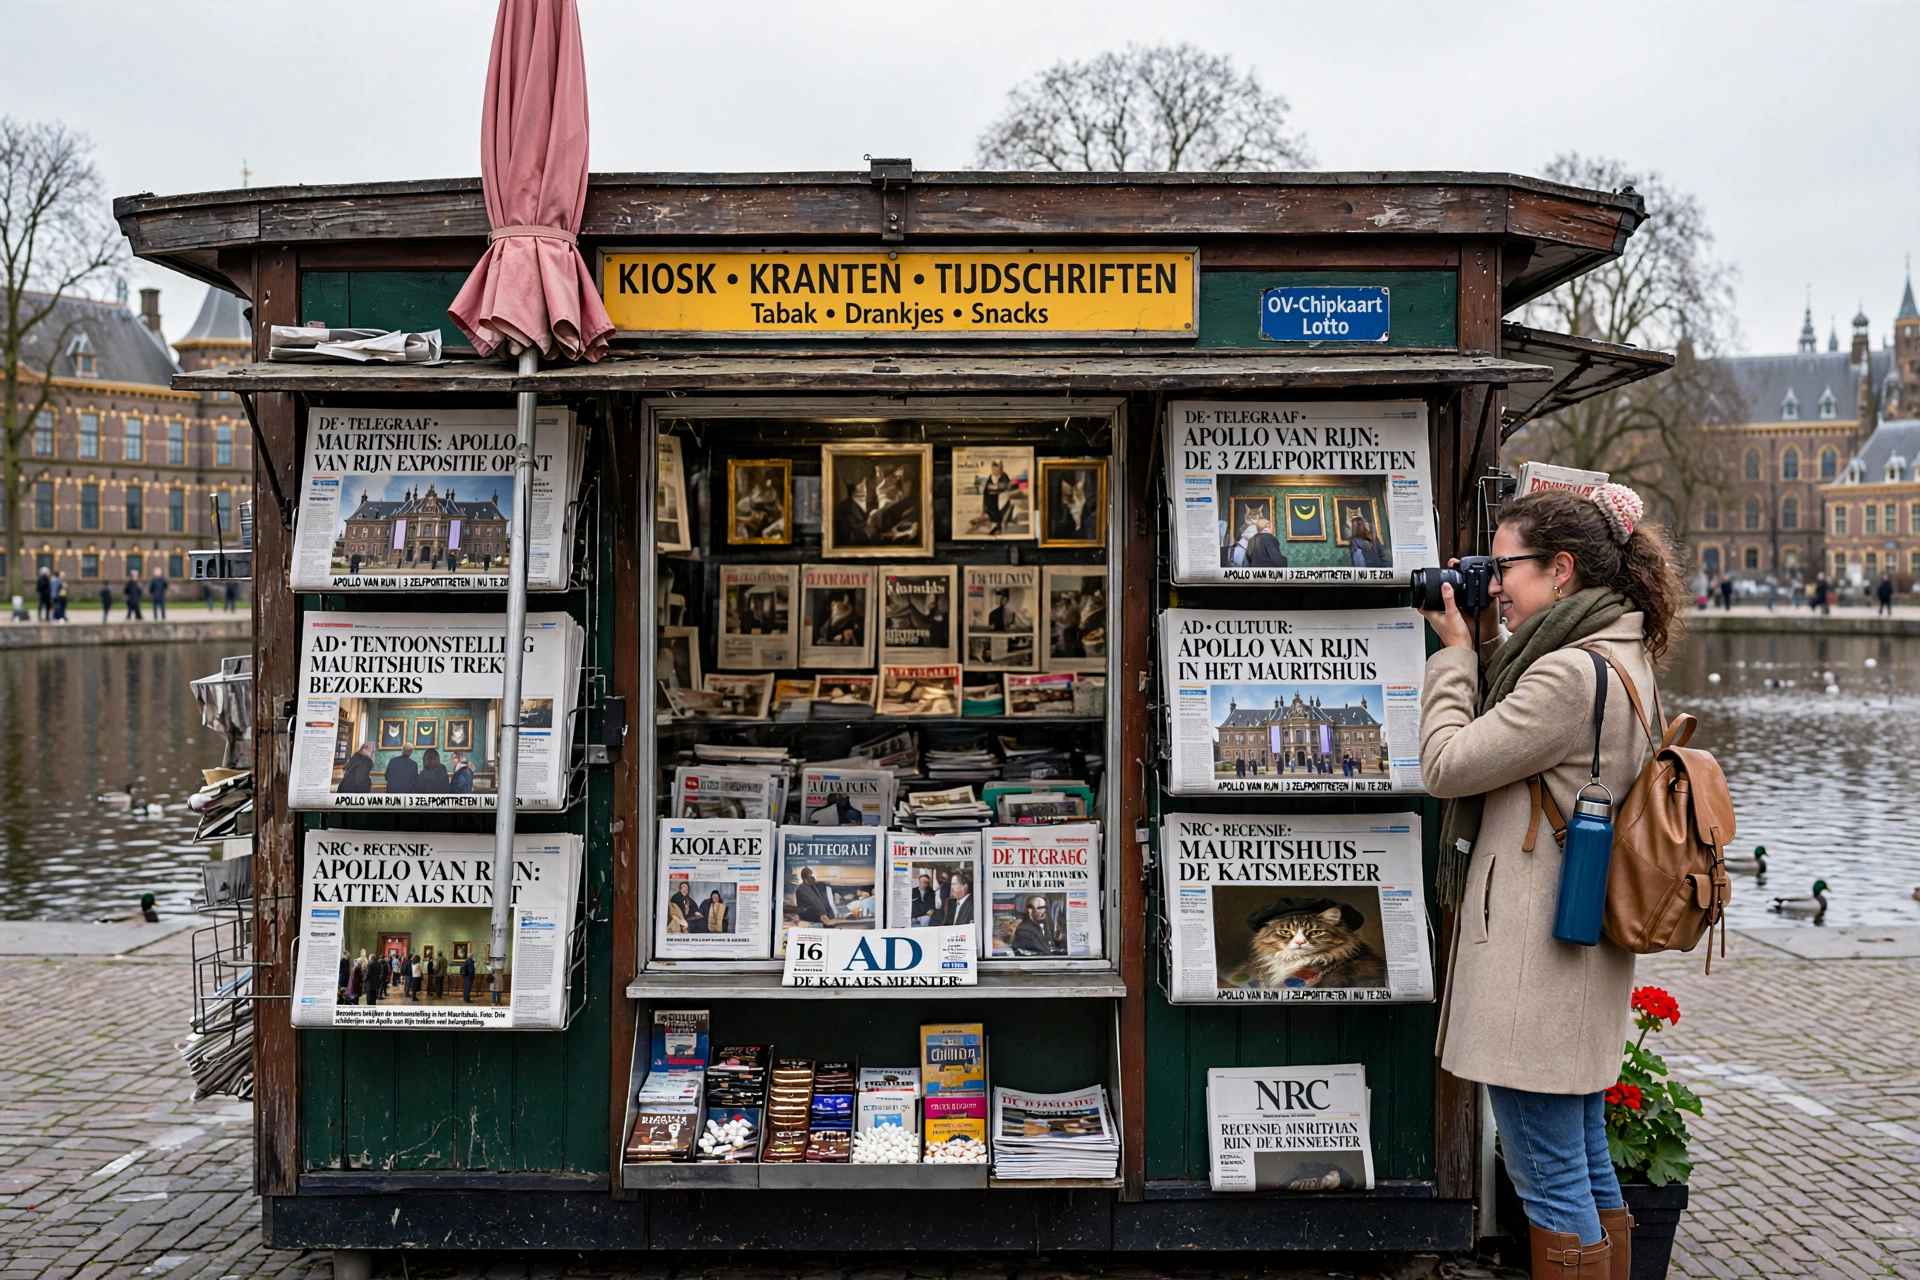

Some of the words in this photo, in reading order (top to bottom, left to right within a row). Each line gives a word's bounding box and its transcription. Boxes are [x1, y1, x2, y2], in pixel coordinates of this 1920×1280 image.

[619, 263, 715, 294] KIOSK
[751, 263, 901, 294] KRANTEN
[935, 263, 1176, 294] TIJDSCHRIFTEN
[1268, 295, 1383, 317] OV-Chipkaart
[751, 303, 817, 324] Tabak
[845, 302, 943, 329] Drankjes
[972, 302, 1048, 324] Snacks
[1303, 318, 1349, 335] Lotto
[319, 417, 339, 430] DE
[349, 417, 431, 430] TELEGRAAF
[1185, 411, 1204, 424] DE
[1214, 410, 1299, 424] TELEGRAAF
[315, 433, 442, 451] MAURITSHUIS:
[447, 434, 516, 451] APOLLO
[1184, 428, 1269, 446] APOLLO
[1275, 428, 1317, 446] VAN
[1326, 428, 1379, 449] RIJN:
[314, 454, 348, 472] VAN
[354, 455, 392, 474] RIJN
[397, 454, 487, 472] EXPOSITIE
[492, 454, 552, 472] OPNT
[1185, 451, 1212, 470] DE
[1218, 451, 1228, 470] 3
[1235, 450, 1415, 470] ZELFPORTTRETEN
[333, 577, 361, 587] APOLLO
[363, 577, 379, 587] VAN
[404, 578, 408, 587] 3
[478, 577, 487, 587] NU
[489, 578, 498, 587] TE
[1180, 620, 1204, 634] AD
[1215, 620, 1293, 634] CULTUUR:
[312, 636, 338, 653] AD
[351, 636, 534, 653] TENTOONSTELLIG
[1178, 638, 1264, 658] APOLLO
[1271, 639, 1313, 658] VAN
[1322, 639, 1369, 660] RIJN
[310, 655, 444, 673] MAURITSHUIS
[451, 655, 506, 673] TREK
[1178, 661, 1199, 680] IN
[1206, 661, 1242, 680] HET
[1248, 661, 1377, 681] MAURITSHUIS
[310, 676, 423, 694] BEZOEKERS
[1218, 781, 1244, 791] APOLLO
[1247, 782, 1261, 791] VAN
[1355, 782, 1365, 791] NU
[336, 796, 365, 806] APOLLO
[367, 796, 383, 806] VAN
[409, 797, 413, 806] 3
[485, 797, 494, 806] NU
[1180, 822, 1212, 836] NRC
[1223, 823, 1292, 837] RECENSIE:
[317, 842, 353, 856] NRC
[993, 848, 1015, 865] DE
[1179, 840, 1356, 860] MAURITSHUIS
[313, 860, 411, 881] APOLLO
[418, 860, 466, 881] VAN
[476, 861, 540, 881] RN:
[1179, 863, 1210, 882] DE
[1218, 863, 1381, 882] KATSMEESTER
[313, 883, 399, 903] KATTEN
[405, 884, 444, 904] ALS
[452, 884, 522, 905] KUNT
[796, 943, 823, 960] 16
[842, 936, 923, 971] AD
[1247, 991, 1261, 1000] VAN
[1254, 1080, 1330, 1110] NRC
